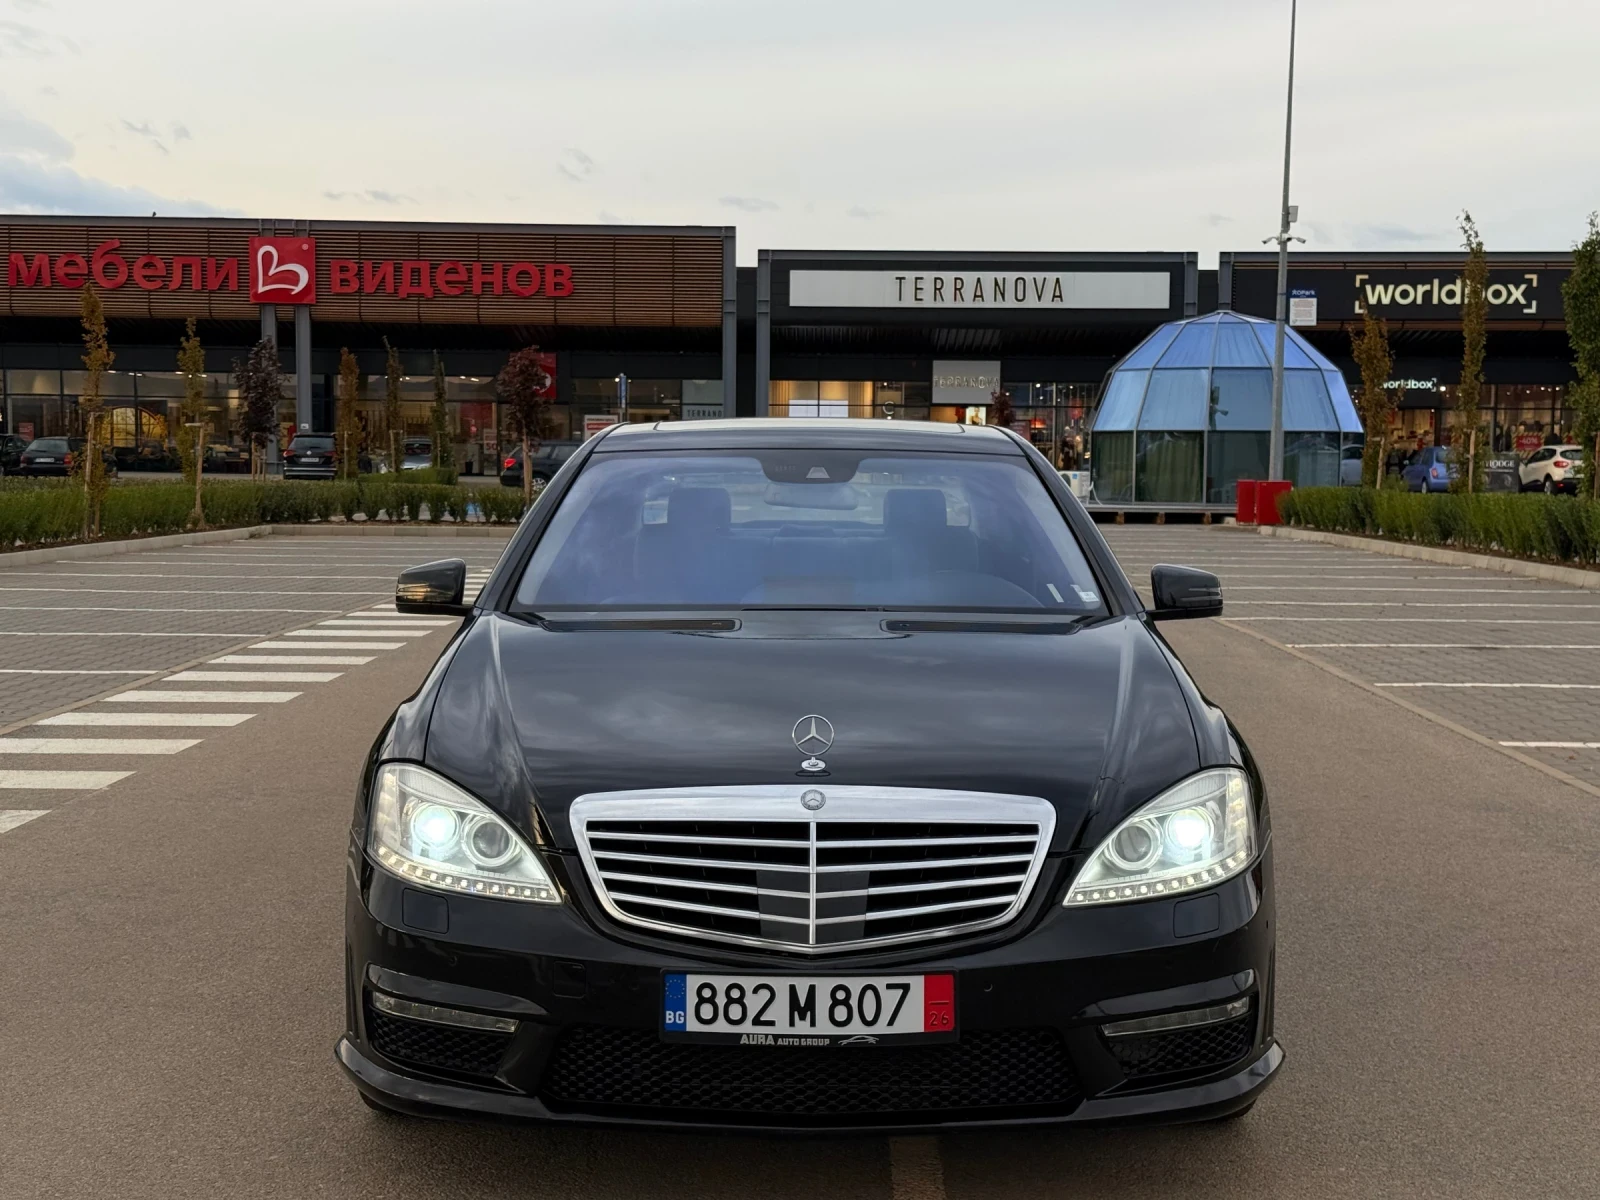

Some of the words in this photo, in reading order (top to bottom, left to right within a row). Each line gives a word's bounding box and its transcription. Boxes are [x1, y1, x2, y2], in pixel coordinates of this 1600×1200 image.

[8, 239, 239, 291] мебели
[330, 260, 574, 299] виденов
[895, 277, 1064, 303] TERRANOVA
[694, 982, 777, 1027] 882
[788, 983, 817, 1028] M
[828, 983, 911, 1028] 807
[665, 1010, 685, 1024] BG
[929, 1010, 950, 1027] 26
[740, 1034, 775, 1045] AURA
[777, 1038, 800, 1046] AUTO
[801, 1038, 830, 1046] GROUP
